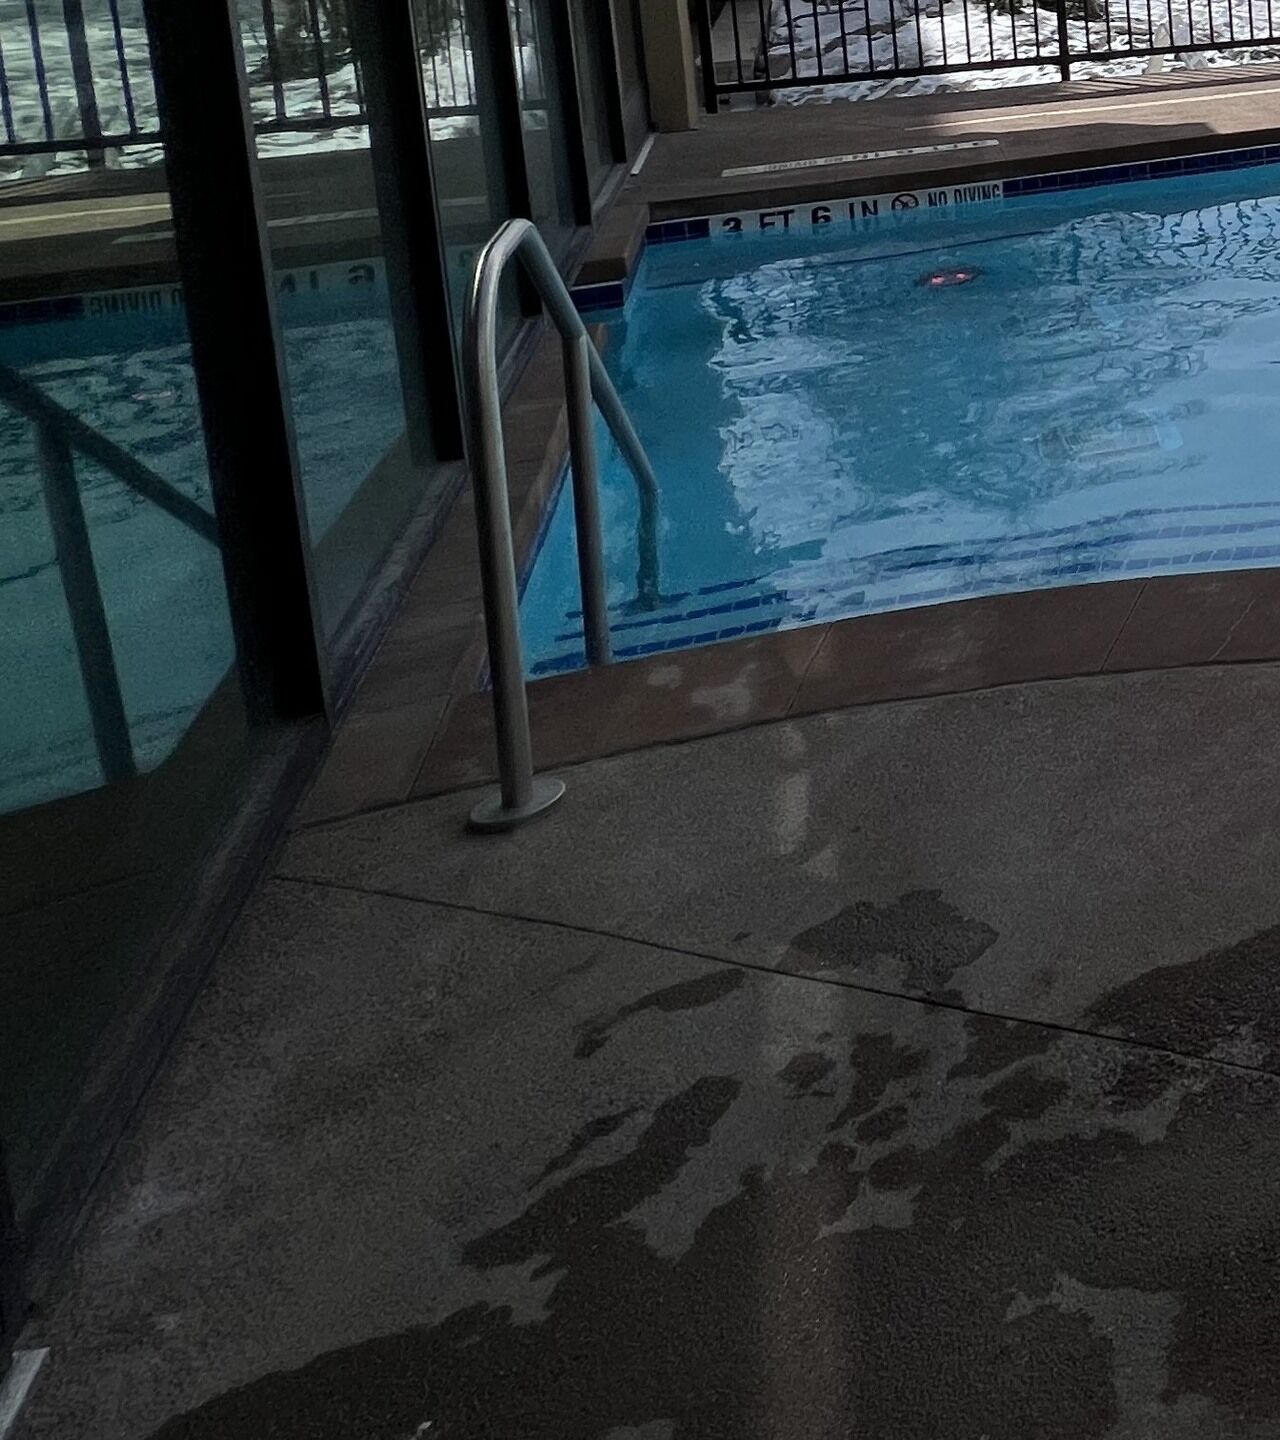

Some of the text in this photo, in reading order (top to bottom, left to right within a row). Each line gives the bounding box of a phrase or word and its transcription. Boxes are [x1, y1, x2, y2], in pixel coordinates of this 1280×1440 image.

[759, 209, 795, 230] FT
[811, 206, 831, 225] 6
[848, 200, 879, 219] IN
[928, 190, 948, 208] NO
[953, 183, 1000, 205] DIVING
